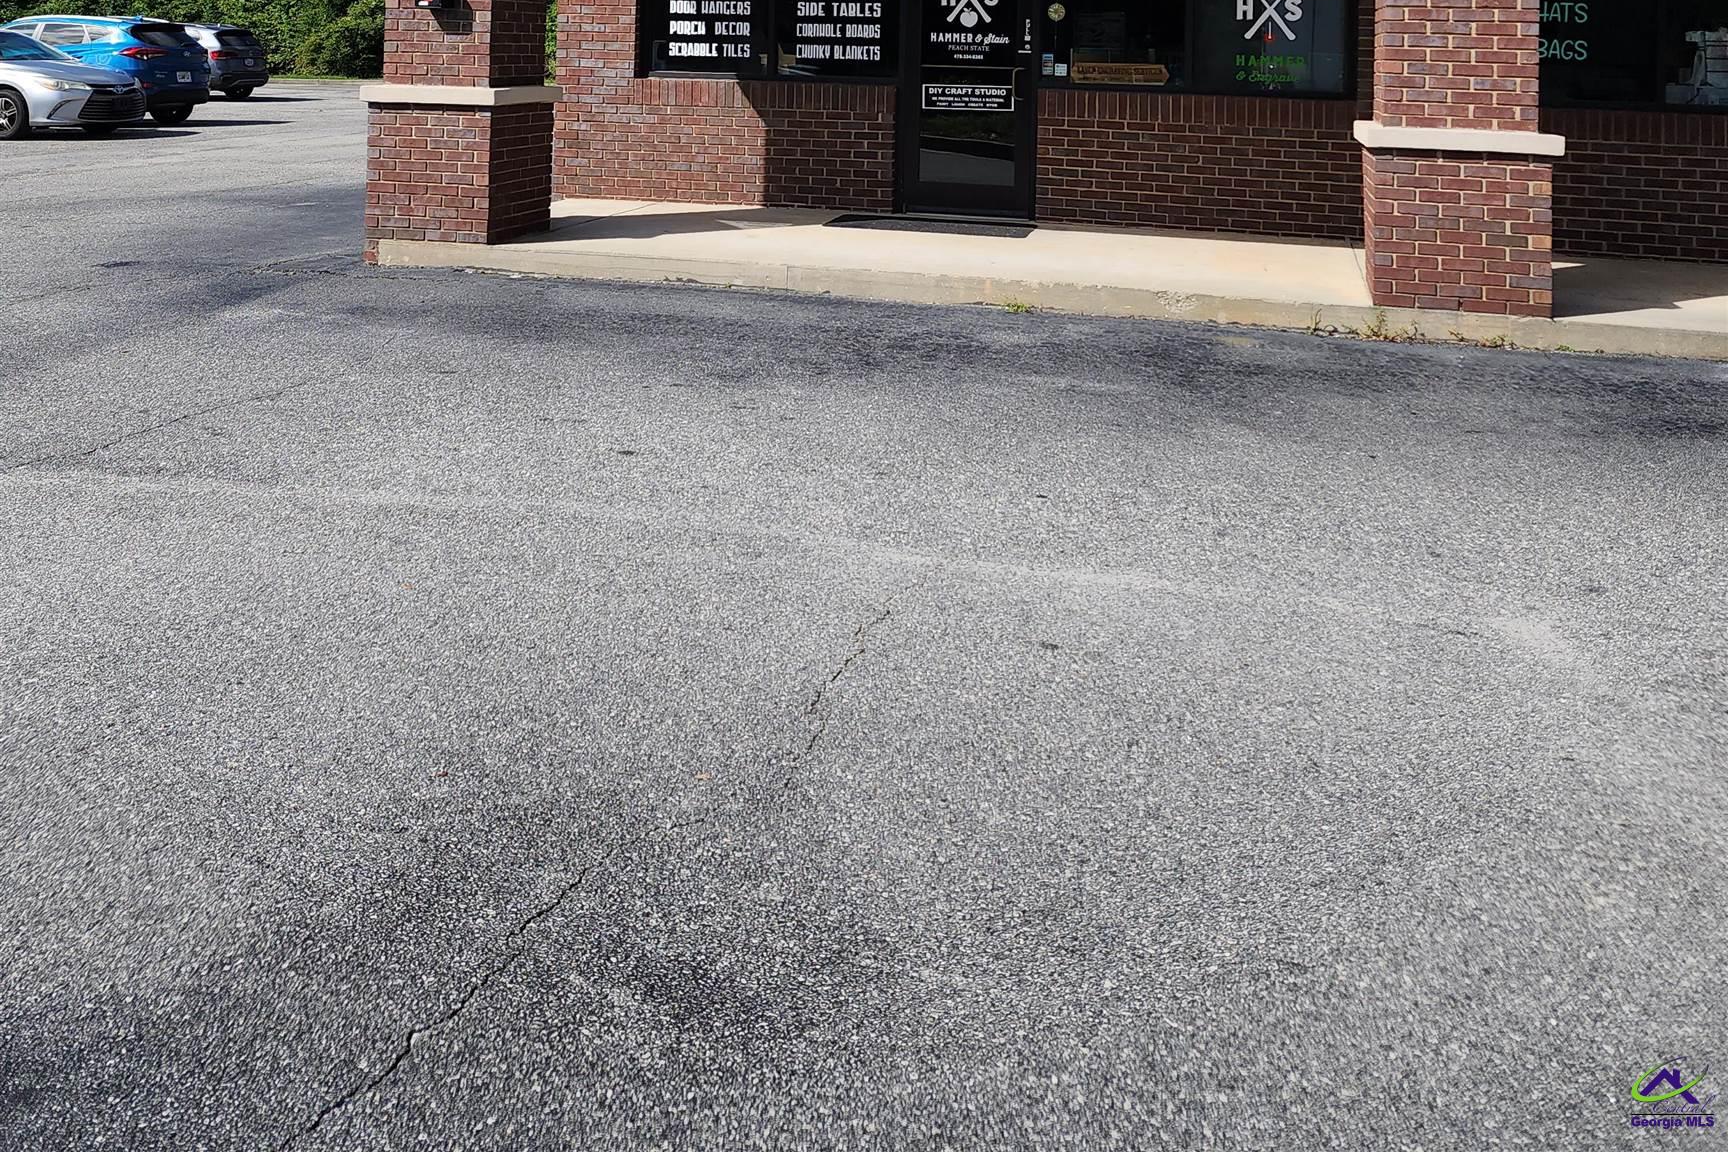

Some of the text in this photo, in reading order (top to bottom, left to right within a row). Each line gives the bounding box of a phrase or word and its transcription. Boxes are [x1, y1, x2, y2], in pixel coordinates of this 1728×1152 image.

[670, 1, 751, 15] DOOR HANGERS
[797, 2, 881, 18] SIDE TABLES
[669, 21, 750, 36] PORCH DECOR
[796, 23, 881, 38] CORNHOLE BOARDS
[930, 32, 1010, 45] HAMMER & Stain
[669, 42, 750, 58] SCRABBLE TILES
[796, 44, 881, 61] CHUNKY BLANKETS
